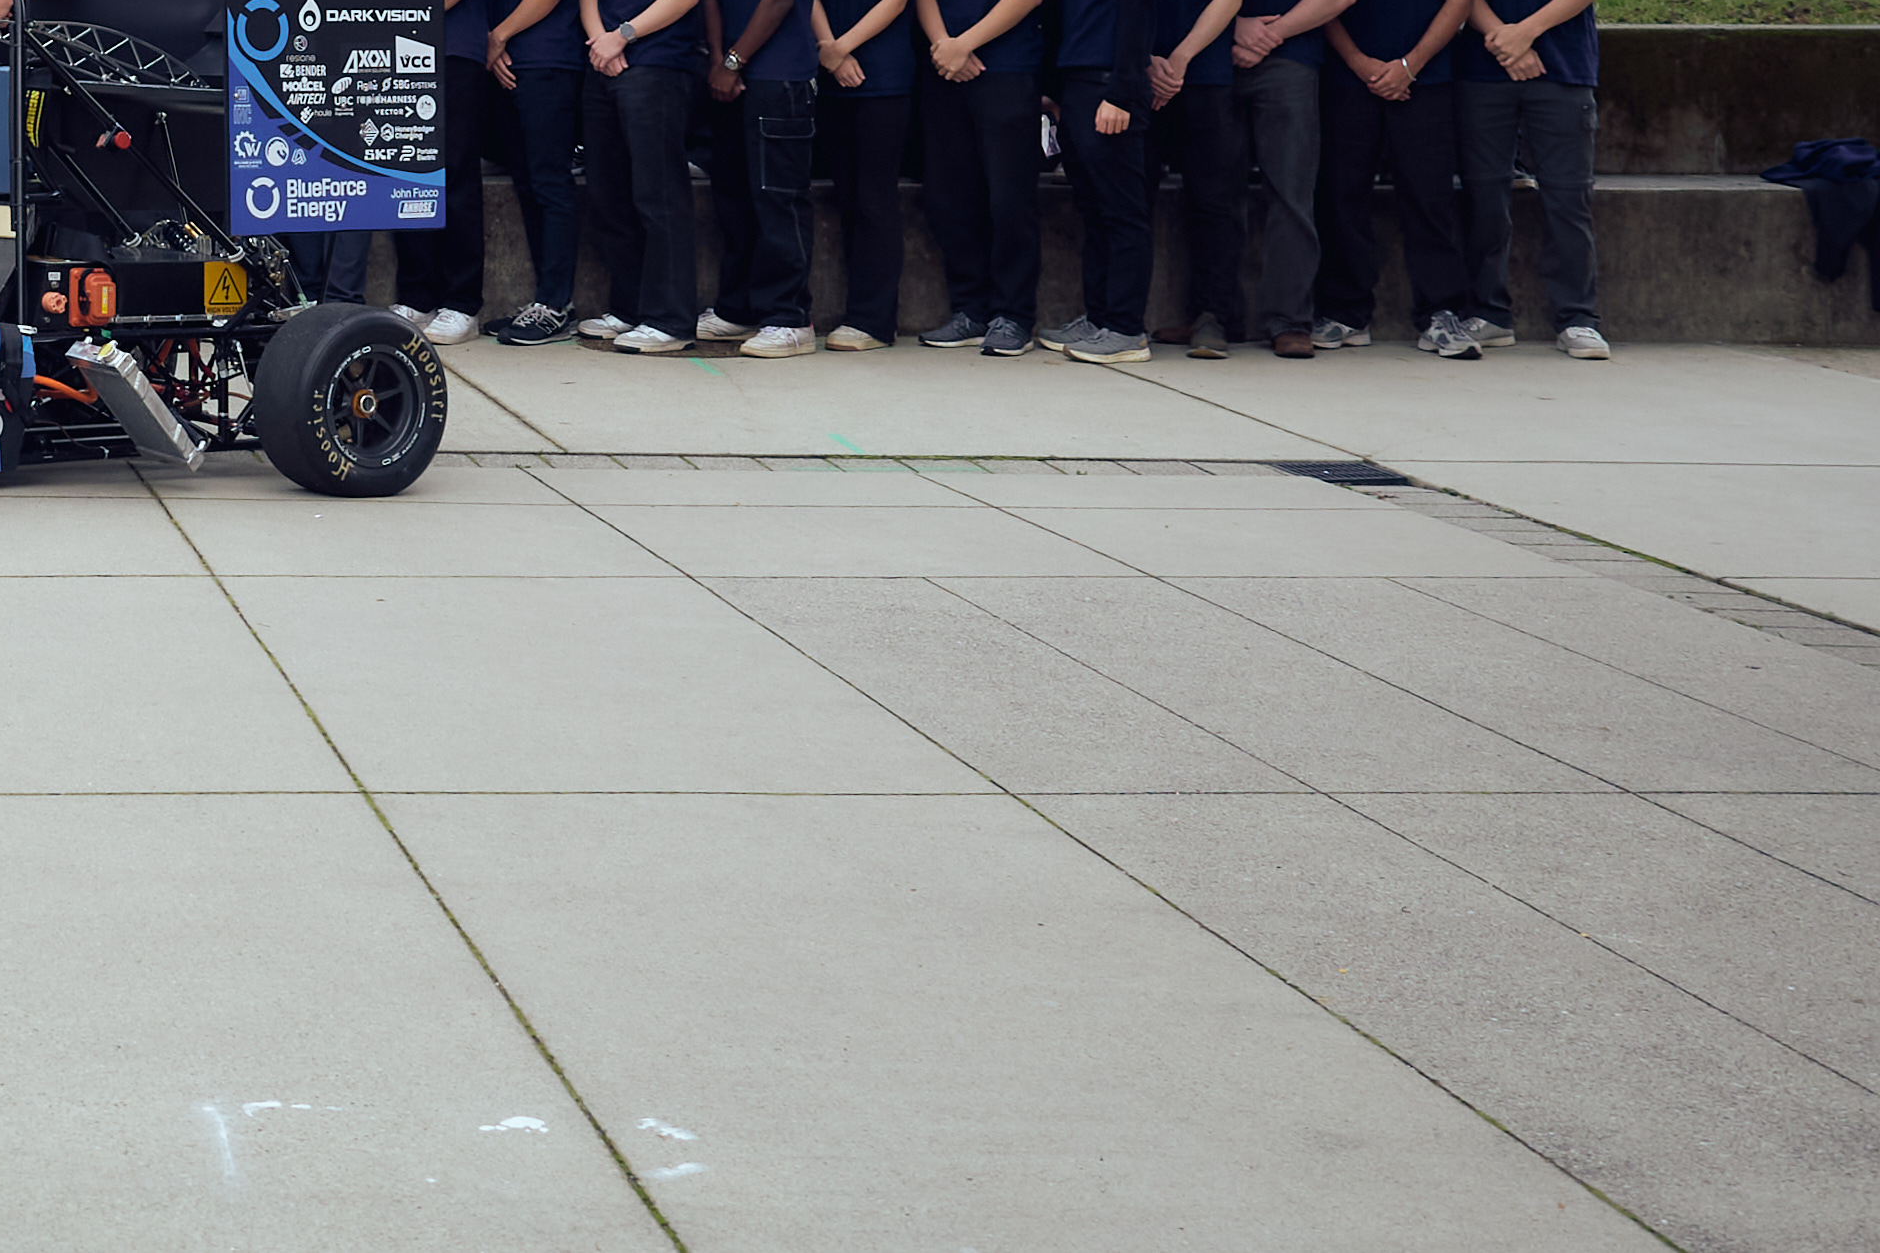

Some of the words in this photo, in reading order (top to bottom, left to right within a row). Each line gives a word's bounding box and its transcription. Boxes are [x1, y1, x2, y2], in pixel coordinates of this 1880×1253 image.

[326, 9, 431, 23] DARKVISION
[342, 49, 391, 74] AXON
[399, 55, 432, 68] VCC
[295, 64, 327, 77] BENDER
[392, 79, 410, 90] SBG
[286, 93, 327, 105] AIRTECH
[374, 108, 404, 116] VECTOR
[363, 148, 398, 161] SKF
[286, 178, 367, 199] BlueForce
[390, 187, 412, 199] John
[286, 199, 347, 222] Energy
